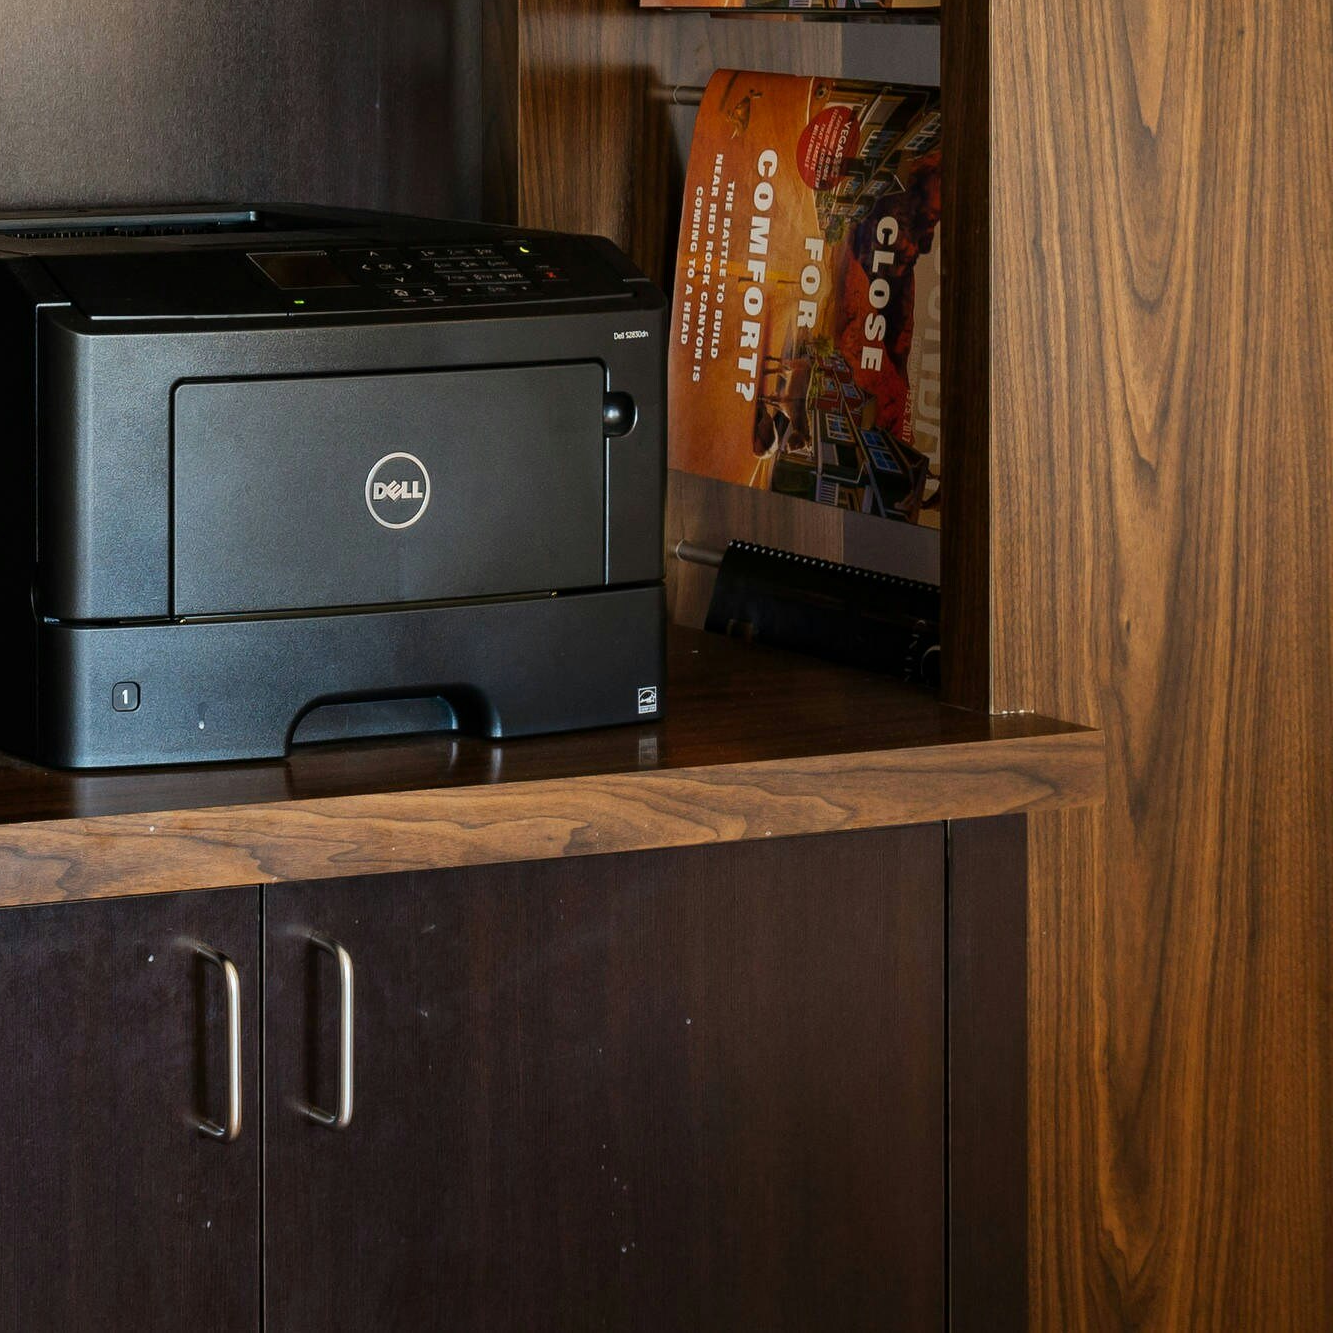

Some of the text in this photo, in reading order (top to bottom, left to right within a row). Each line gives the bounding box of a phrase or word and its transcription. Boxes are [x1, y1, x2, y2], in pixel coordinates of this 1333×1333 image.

[680, 186, 703, 345] COMING TO A HEAD
[693, 154, 724, 382] NEAR RED ROCK CANYON IS
[710, 181, 735, 358] THE BATTLE TO BUILD
[735, 149, 778, 402] COMFORT?
[797, 237, 825, 329] FOR
[861, 216, 899, 372] CLOSE
[373, 480, 423, 501] DELL
[122, 689, 129, 705] 1
